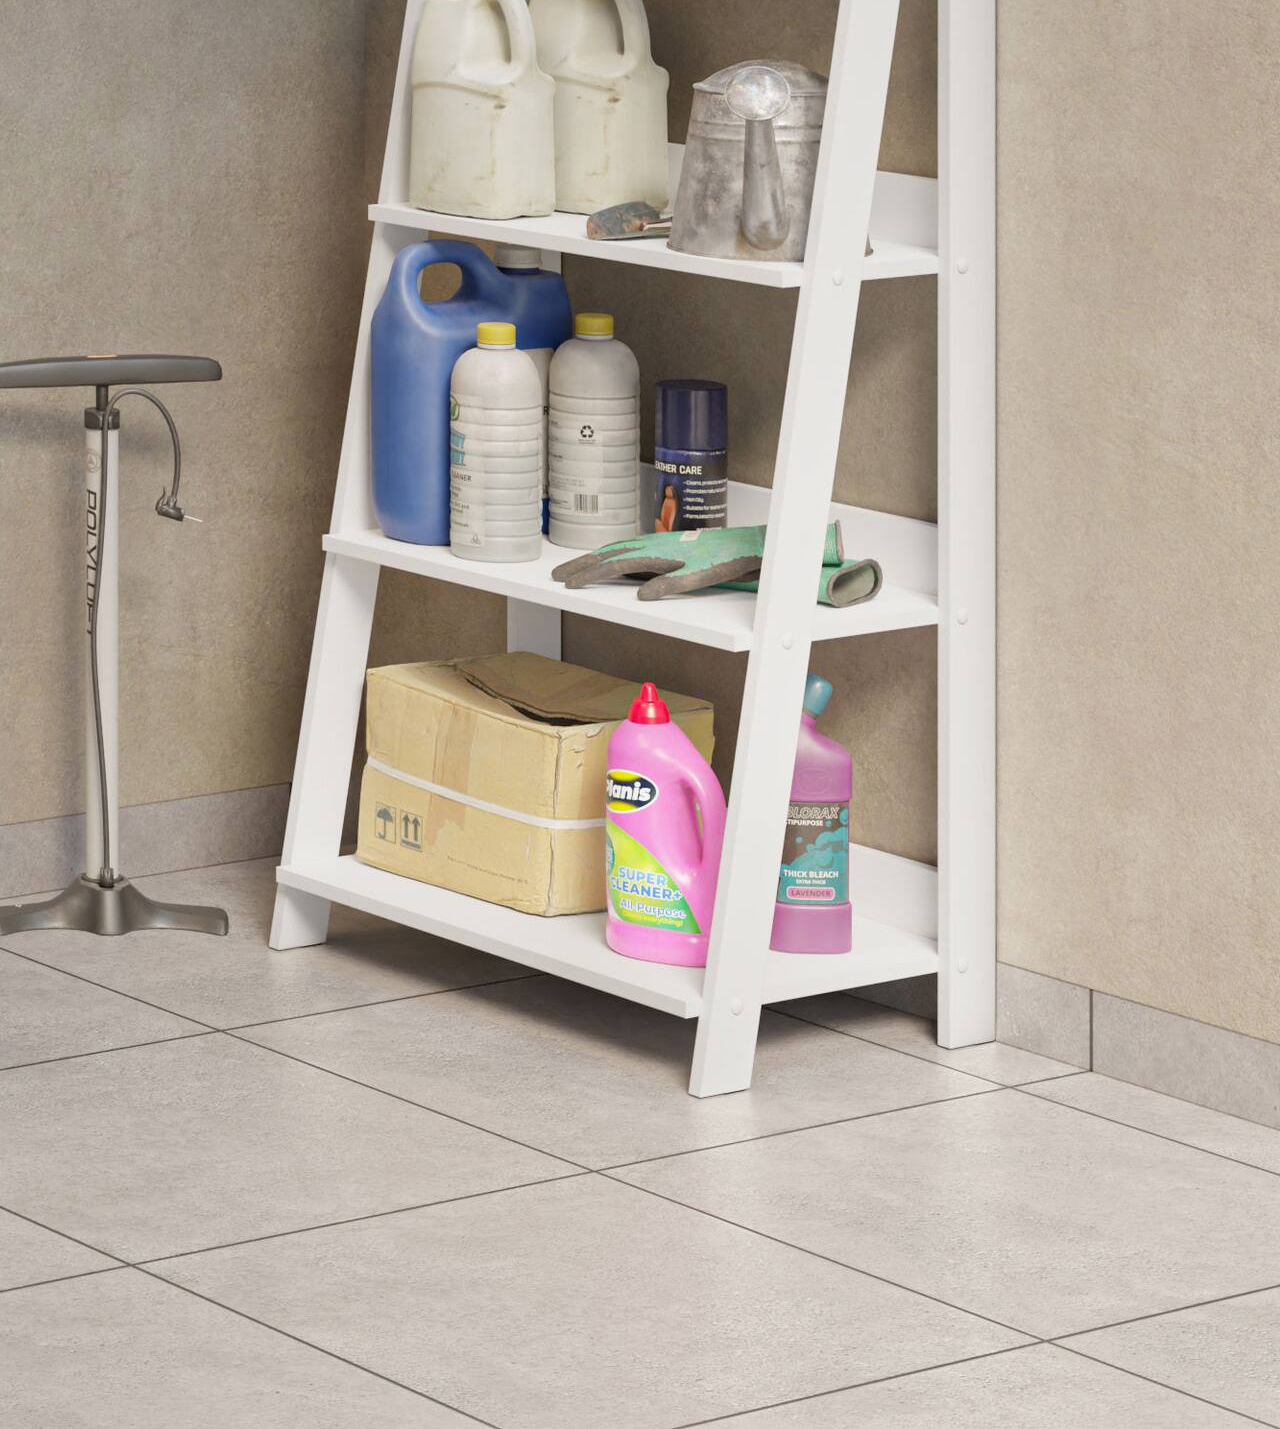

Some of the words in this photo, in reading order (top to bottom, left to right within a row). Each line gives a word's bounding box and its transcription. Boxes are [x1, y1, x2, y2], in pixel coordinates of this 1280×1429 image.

[679, 465, 703, 475] CARE
[618, 866, 667, 886] SUPER
[784, 869, 808, 878] THICK
[809, 870, 839, 878] BLEACH
[610, 877, 682, 900] CLEANER+
[620, 899, 687, 919] All-Purpose
